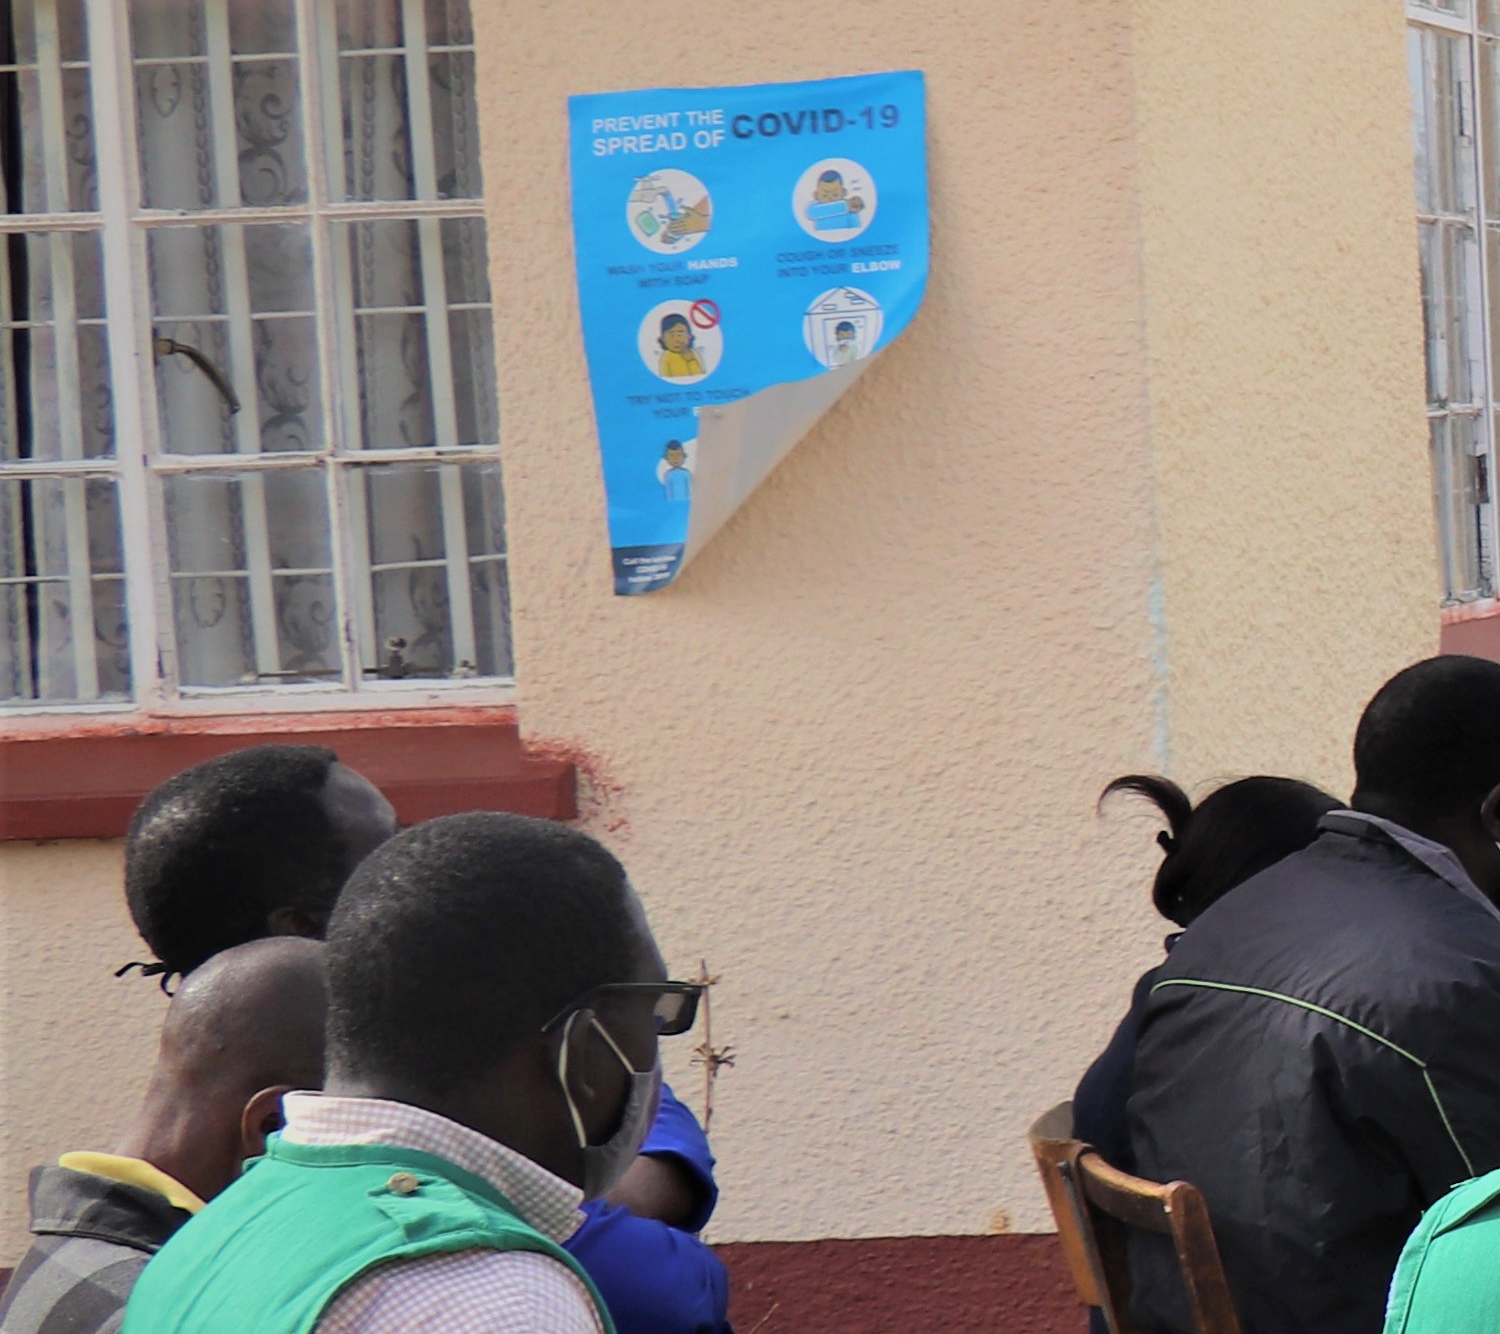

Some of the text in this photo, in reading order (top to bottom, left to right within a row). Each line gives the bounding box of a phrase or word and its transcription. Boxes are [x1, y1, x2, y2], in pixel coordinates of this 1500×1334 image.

[592, 109, 725, 134] PREVENT THE
[731, 104, 899, 140] COVID-19
[592, 129, 725, 156] SPREAD OF
[687, 256, 739, 270] HANDS
[851, 259, 902, 274] ELBOW
